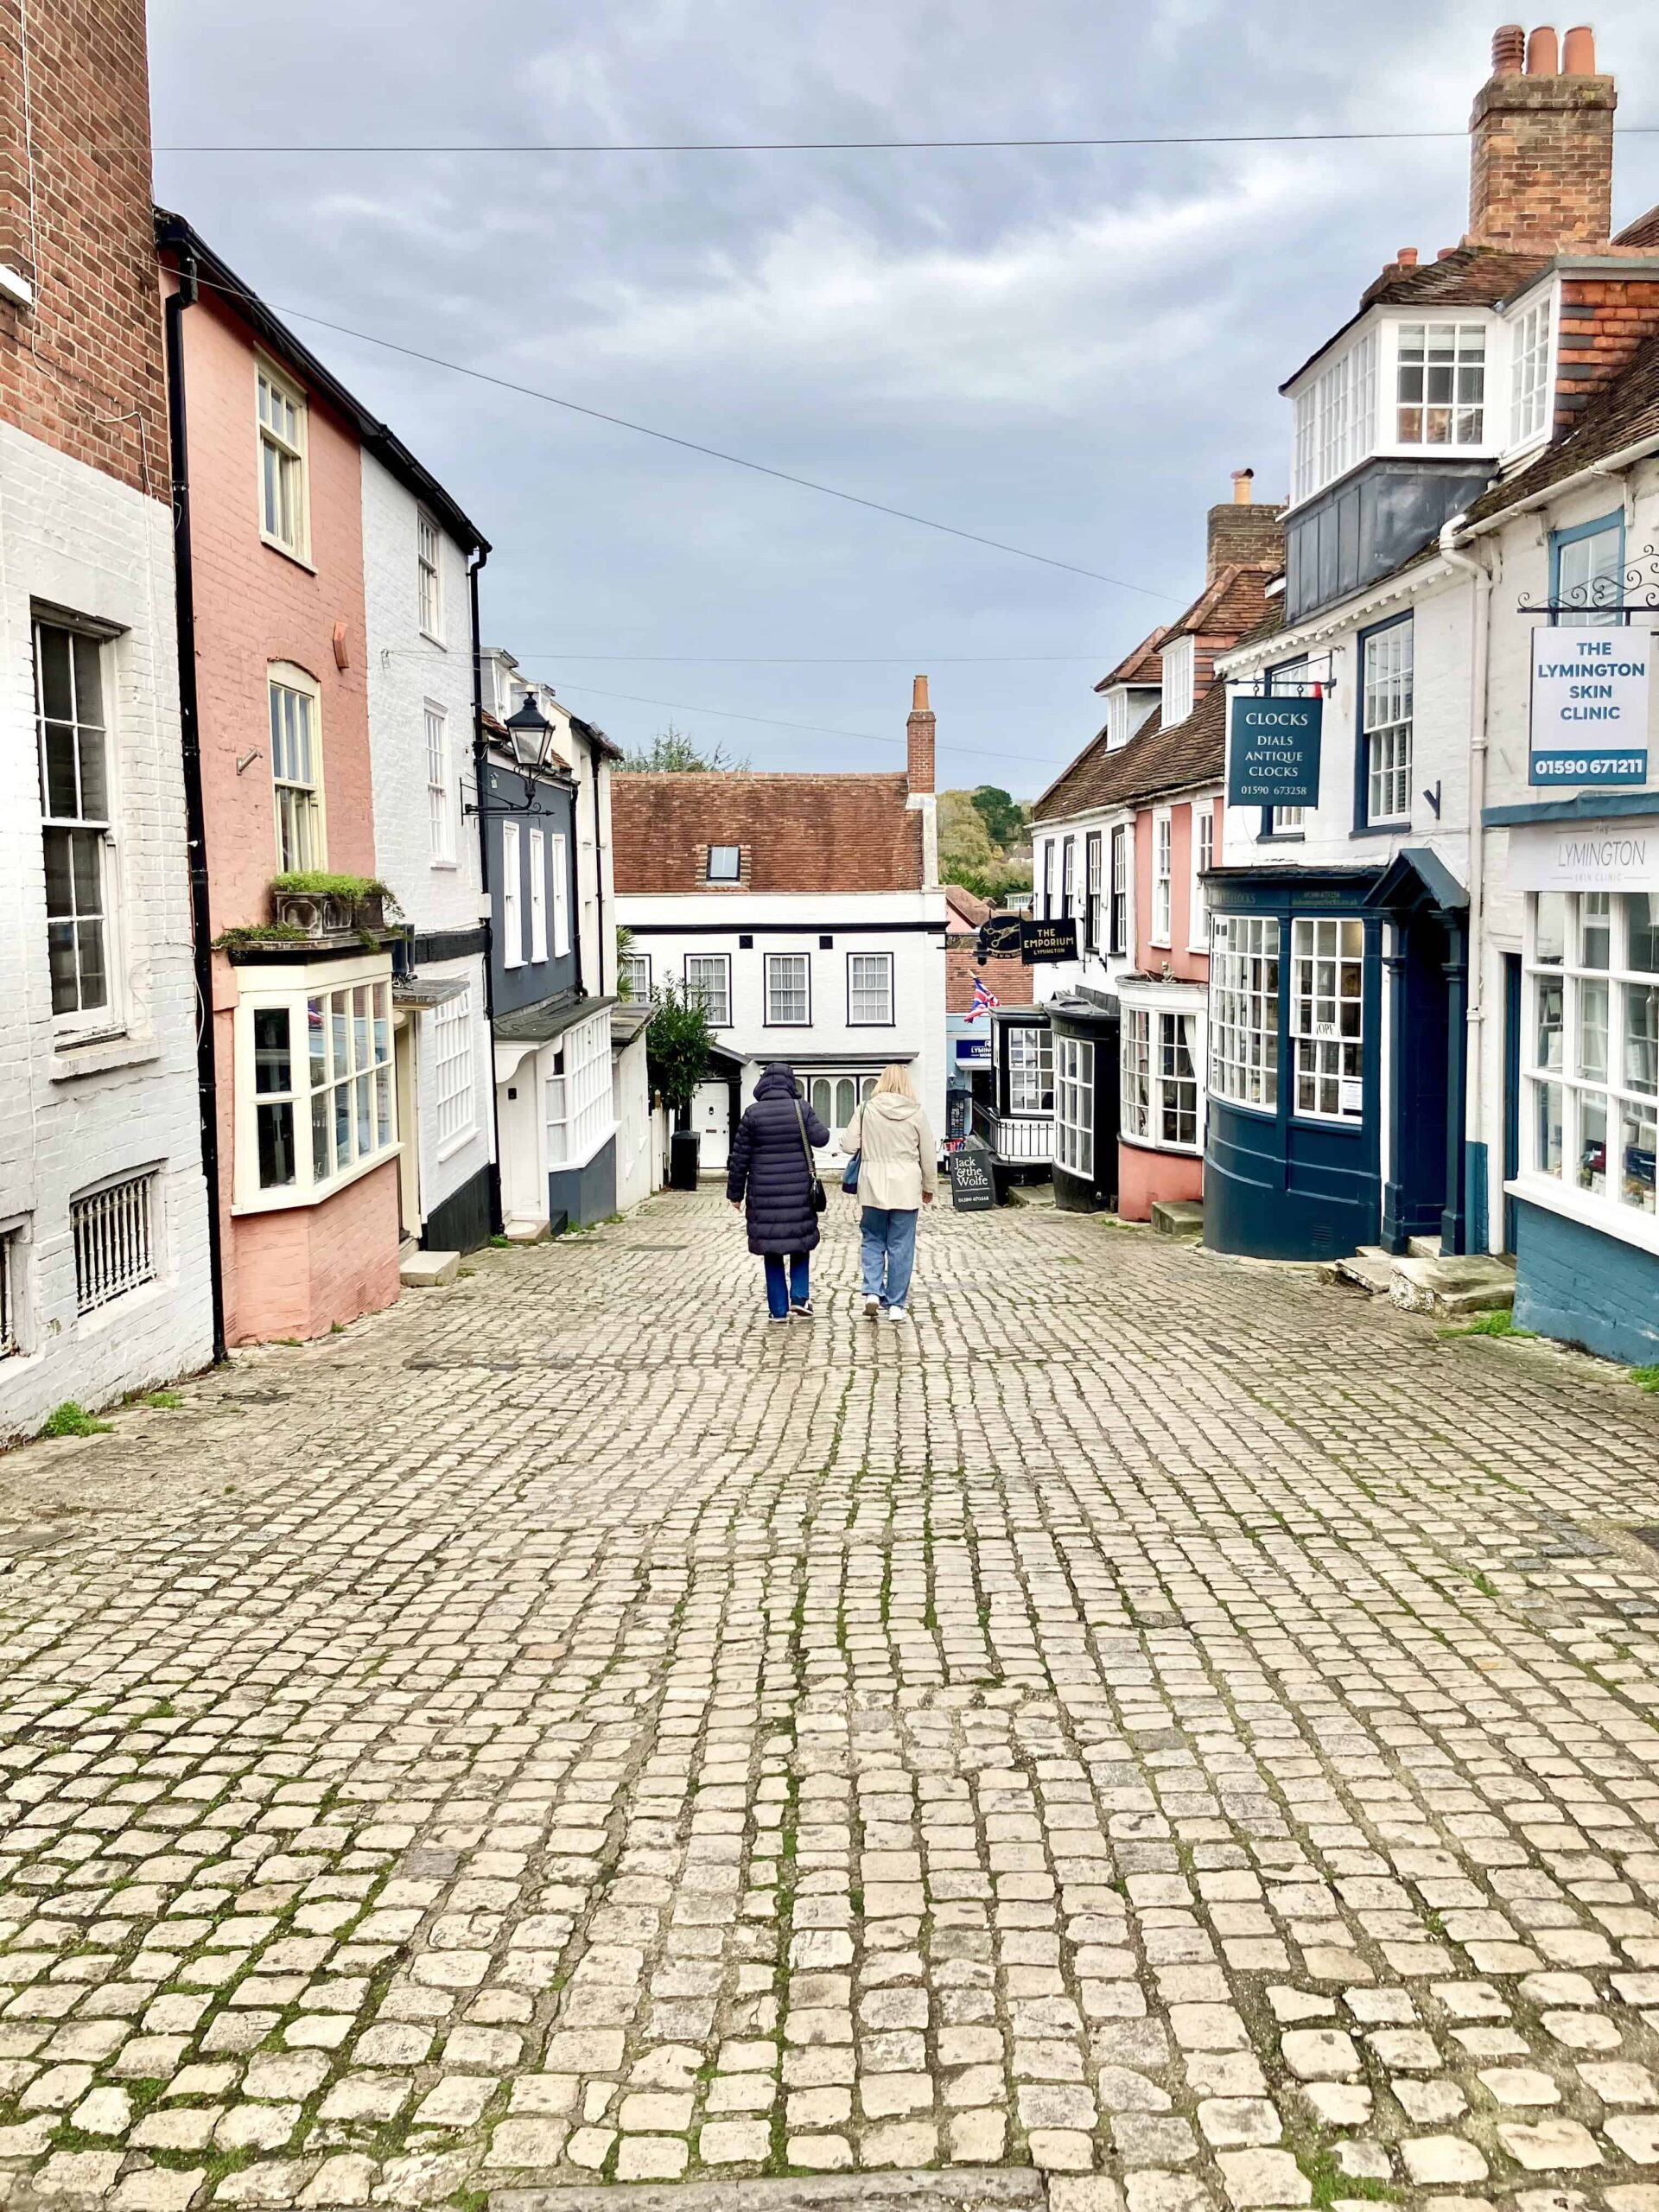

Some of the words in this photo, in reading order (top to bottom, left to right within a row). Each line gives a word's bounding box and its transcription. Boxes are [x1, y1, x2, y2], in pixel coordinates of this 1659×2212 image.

[1576, 642, 1611, 656] THE
[1537, 663, 1645, 677] LYMINGTON
[1569, 685, 1612, 699] SKIN
[1245, 713, 1308, 726] CLOCKS
[1560, 706, 1621, 721] CLINIC
[1257, 735, 1294, 746] DIALS
[1244, 751, 1303, 763] ANTIQUE
[1249, 766, 1299, 777] CLOCKS
[1535, 760, 1587, 774] 01590
[1589, 759, 1643, 773] 671211
[1241, 785, 1269, 795] 01590
[1273, 786, 1307, 795] 673258
[1558, 840, 1646, 867] LYMINGTON
[1595, 873, 1622, 881] CLINIC
[1037, 928, 1056, 938] THE
[1023, 937, 1074, 949] EMPORIUM
[954, 1156, 976, 1170] Jack
[956, 1168, 966, 1178] &
[966, 1166, 982, 1176] the
[956, 1174, 988, 1187] Wolfe
